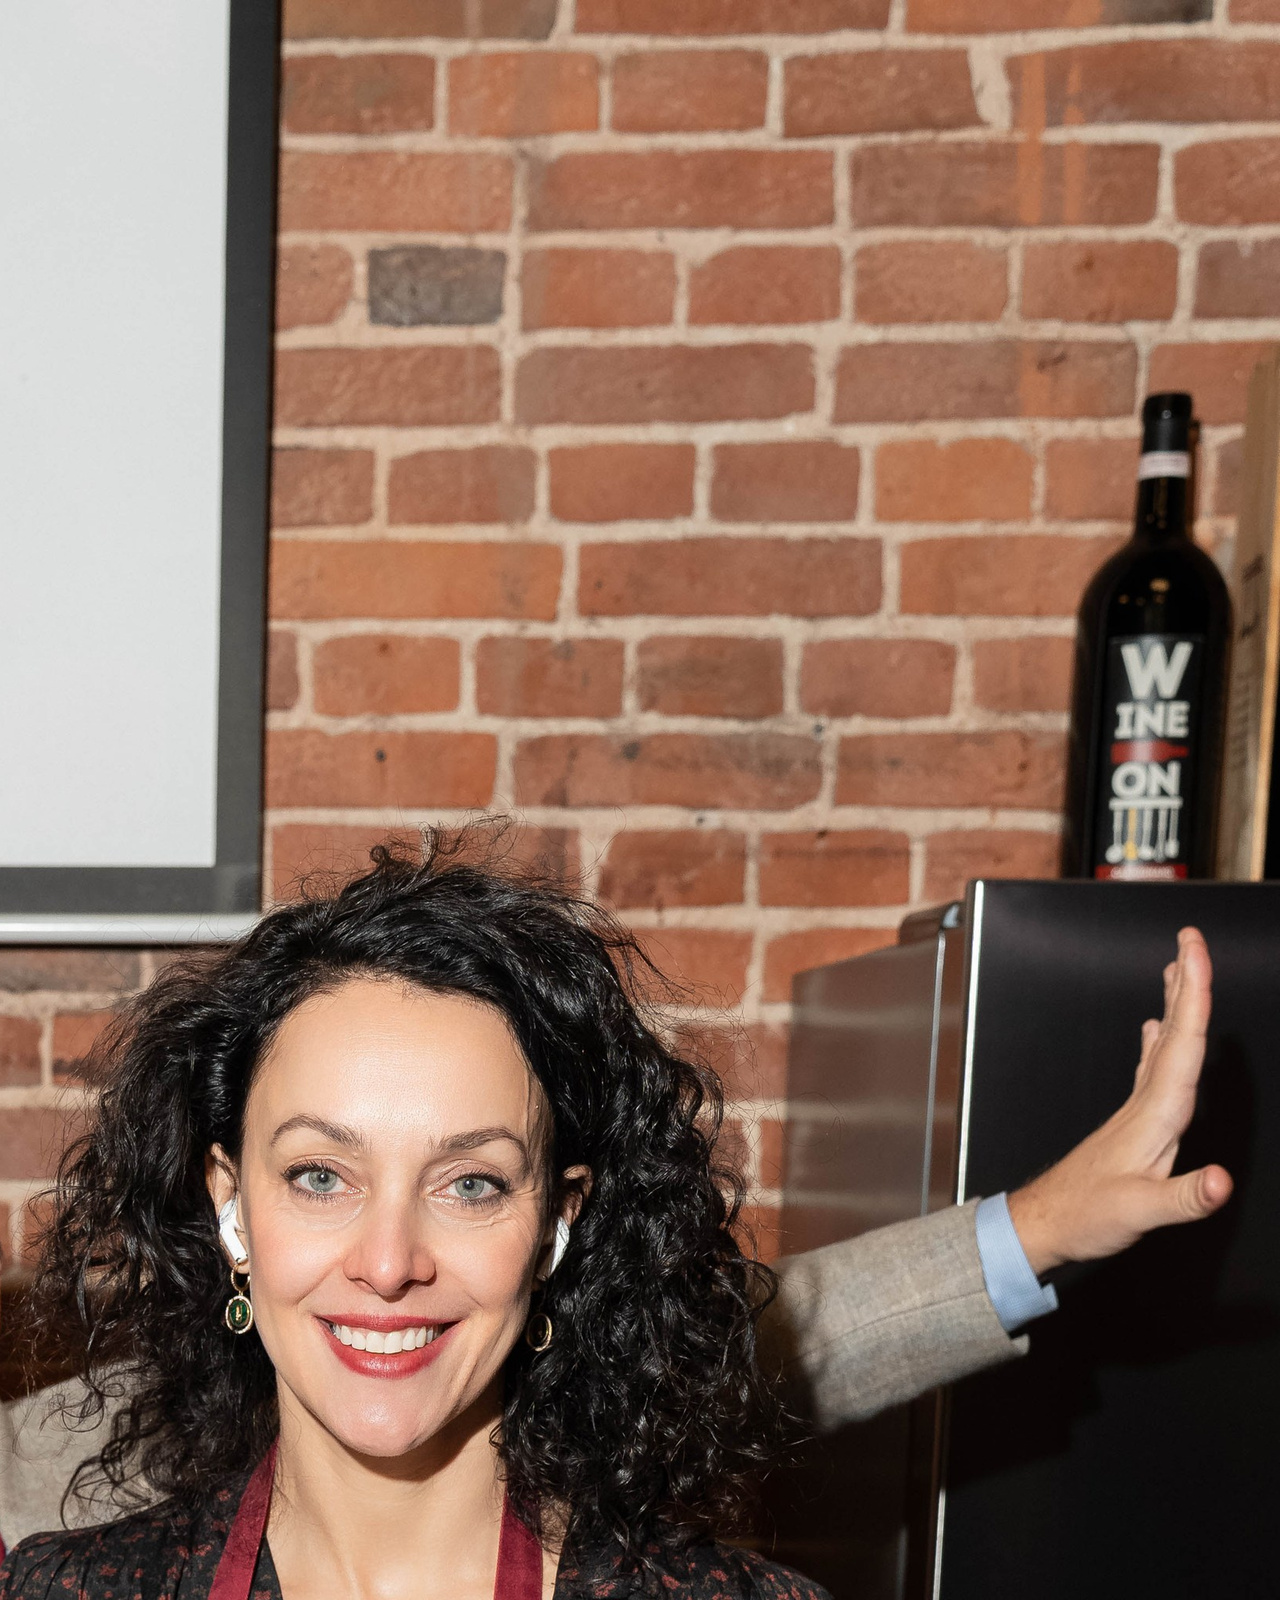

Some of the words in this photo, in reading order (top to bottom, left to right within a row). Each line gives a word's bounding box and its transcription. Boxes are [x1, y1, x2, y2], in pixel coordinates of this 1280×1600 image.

[1120, 641, 1195, 700] W
[1115, 701, 1190, 740] INE
[1111, 761, 1182, 798] ON
